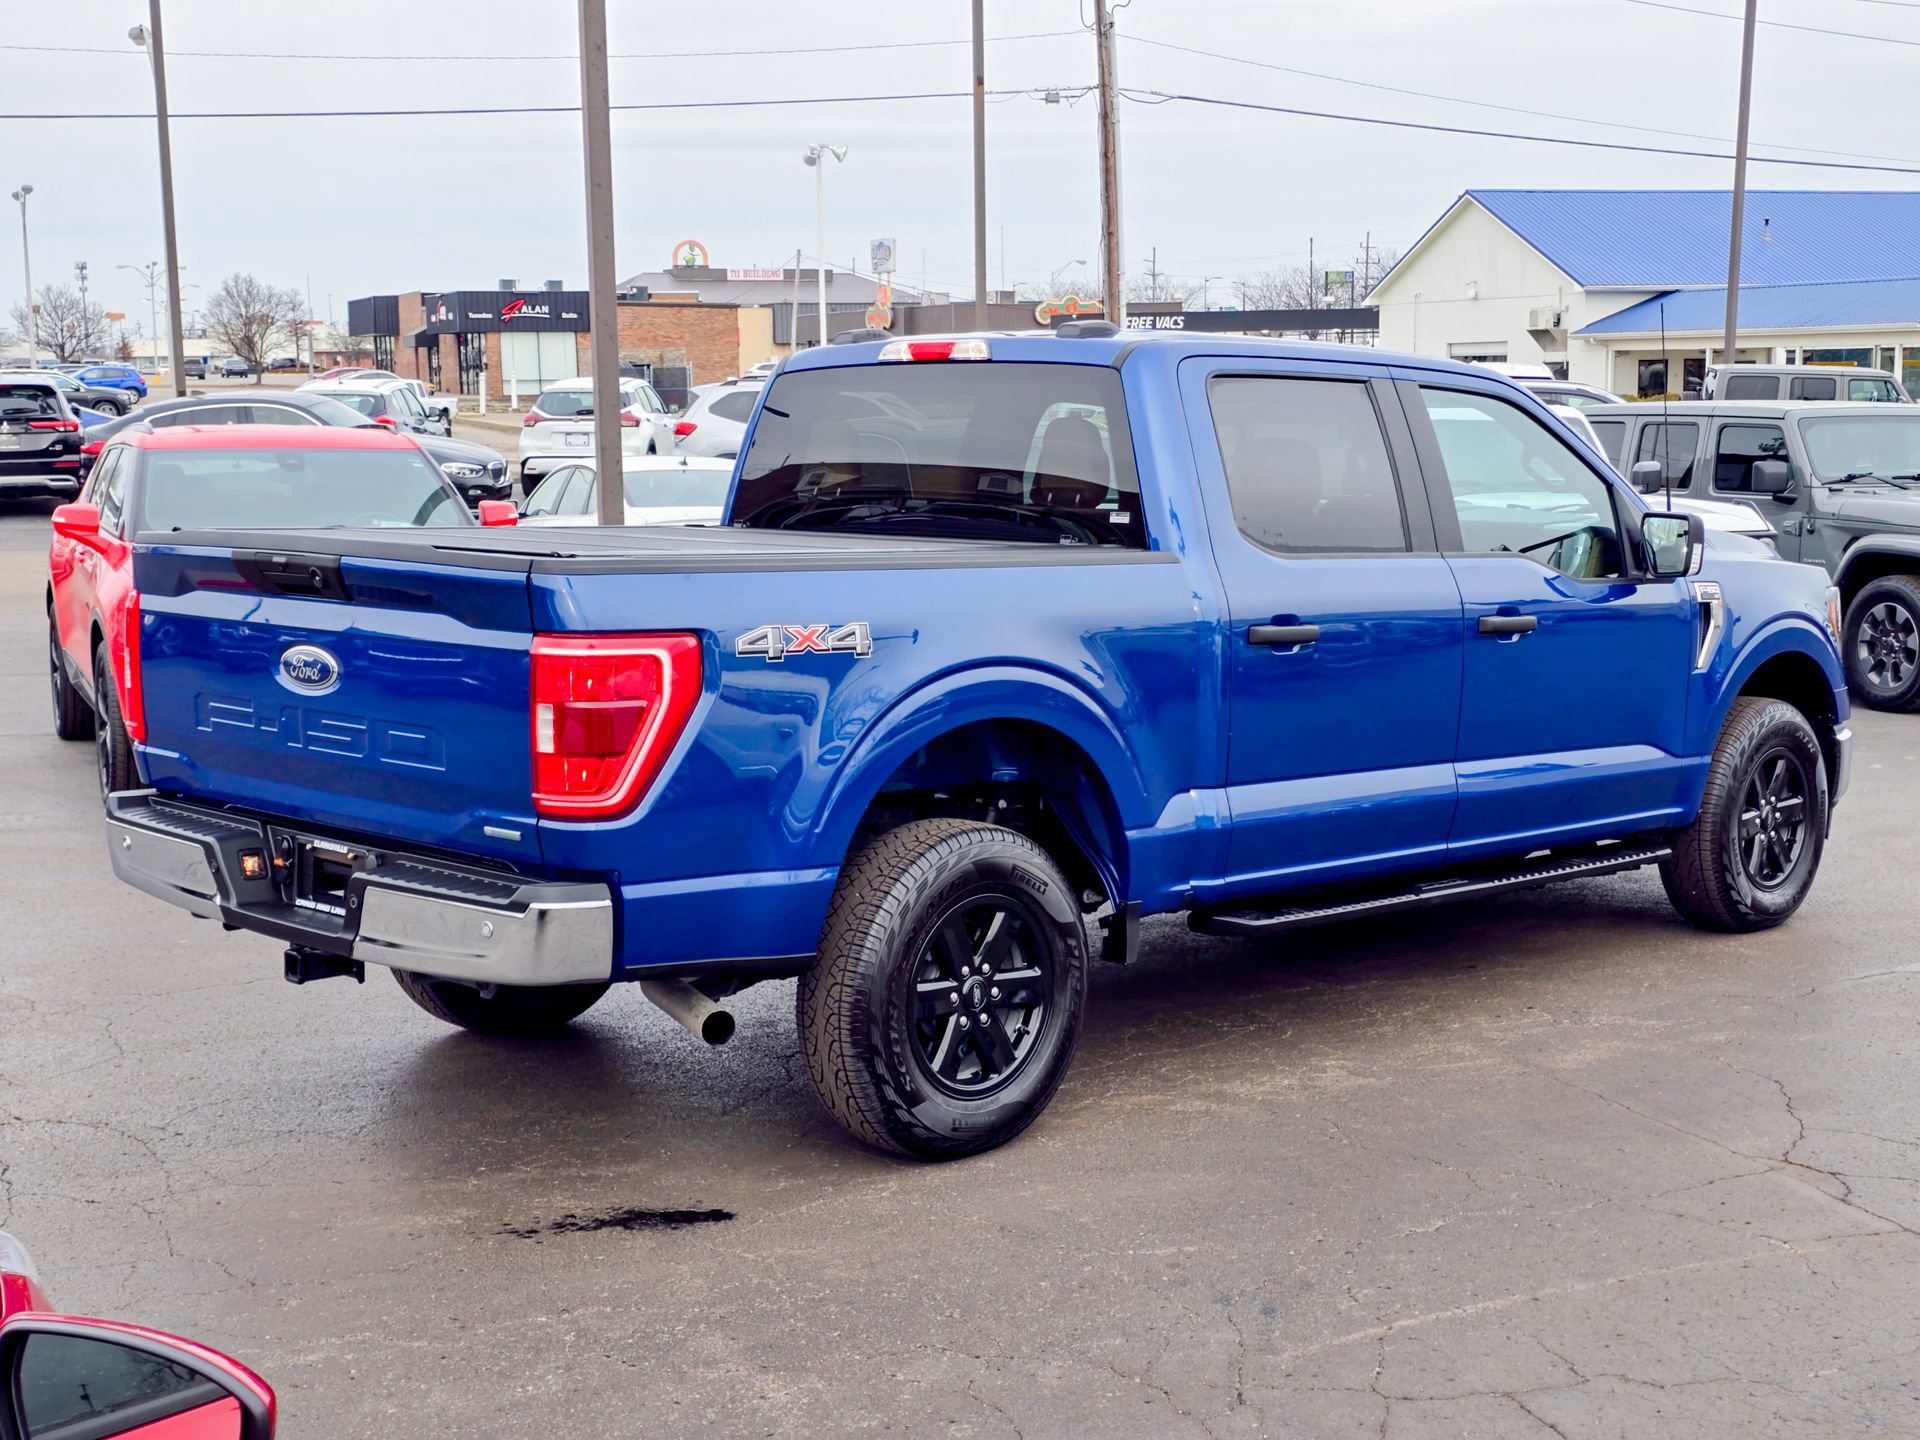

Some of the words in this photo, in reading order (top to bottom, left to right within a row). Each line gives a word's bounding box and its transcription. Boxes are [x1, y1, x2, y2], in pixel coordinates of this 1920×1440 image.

[743, 269, 781, 279] BUILDING
[520, 305, 549, 314] ALAN
[1126, 316, 1154, 330] FREE
[1155, 315, 1185, 330] VACS
[289, 655, 321, 681] Ford
[194, 691, 447, 771] F-150
